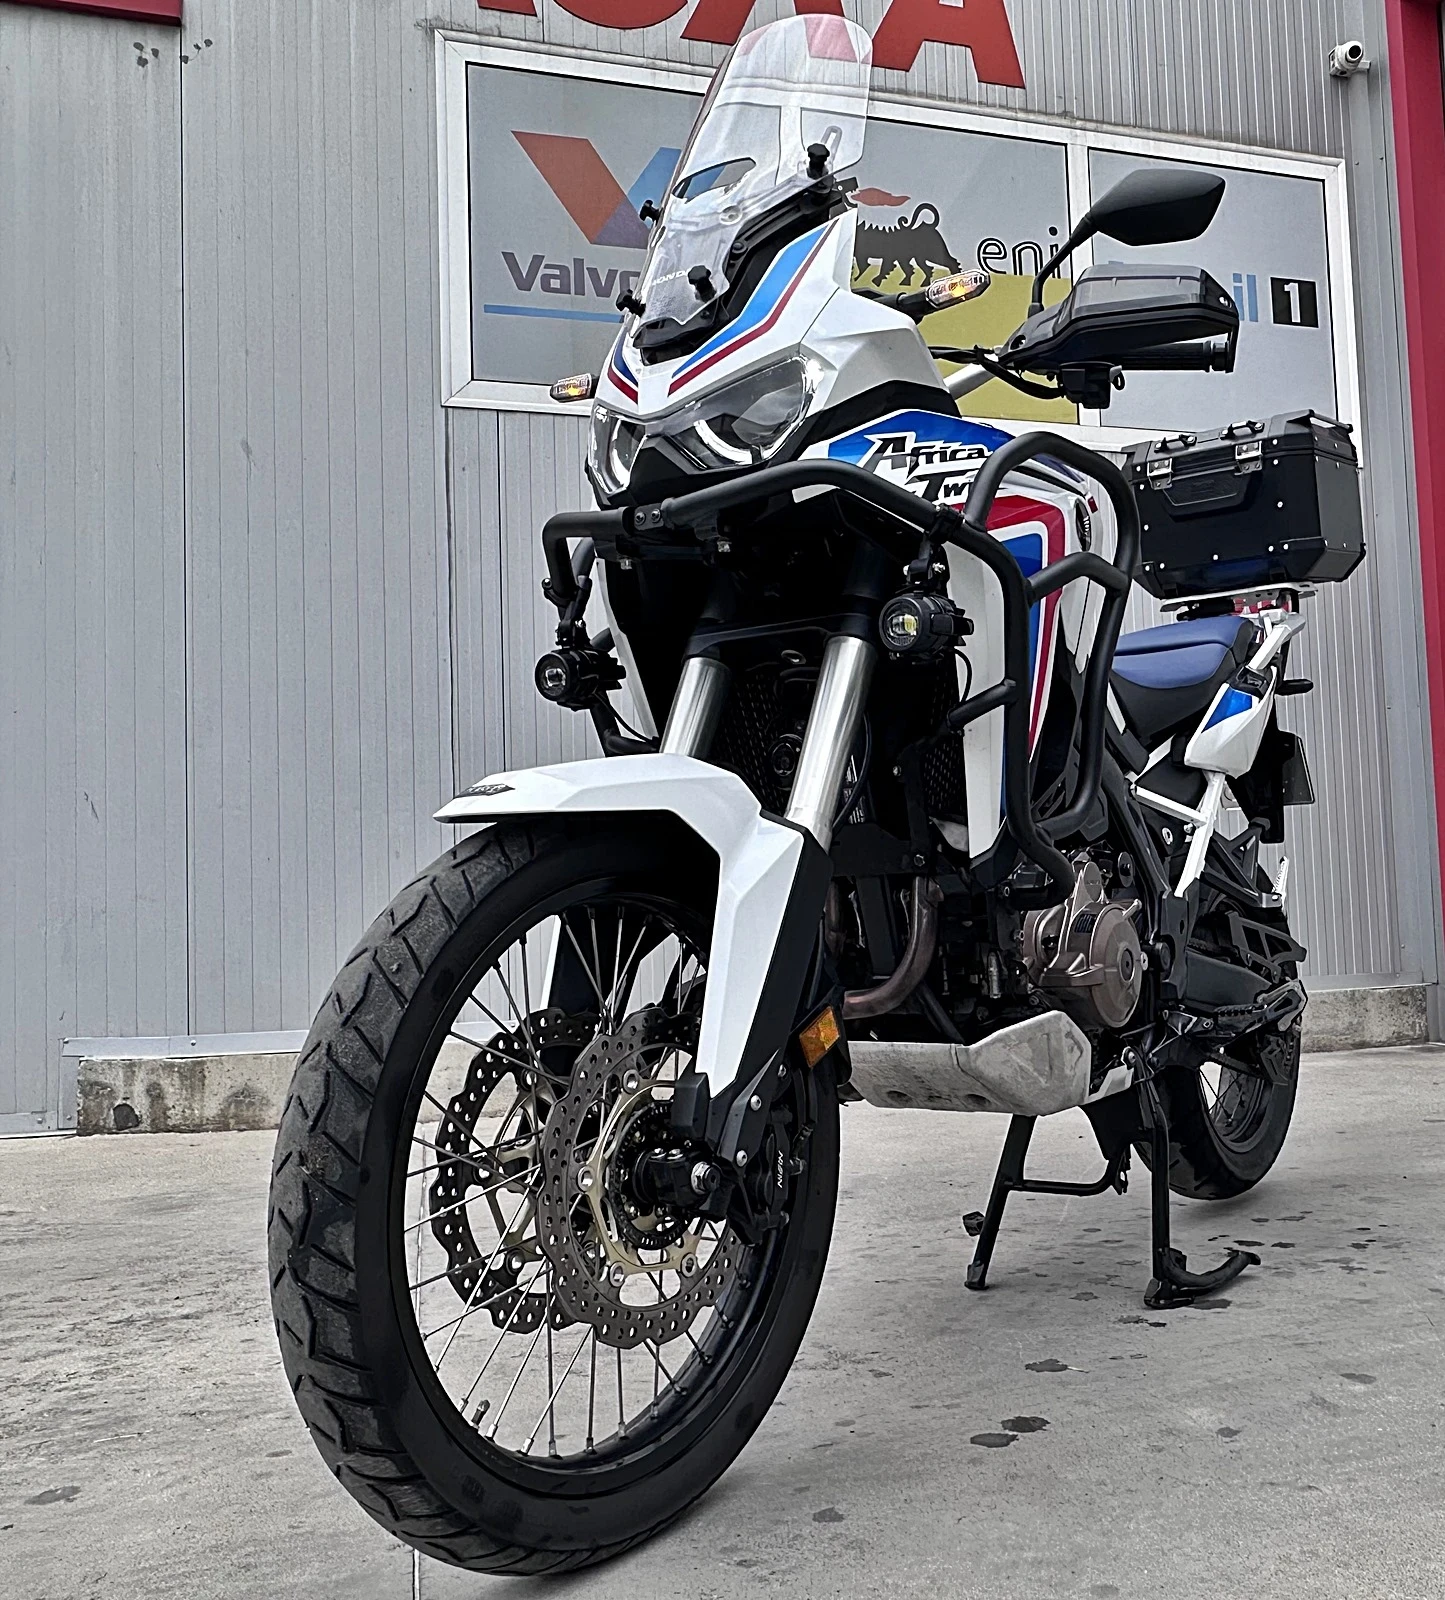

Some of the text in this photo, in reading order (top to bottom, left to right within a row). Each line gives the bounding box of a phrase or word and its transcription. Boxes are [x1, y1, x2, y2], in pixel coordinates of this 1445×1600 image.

[977, 226, 1062, 279] eni
[652, 268, 690, 286] HOND
[1284, 282, 1301, 323] 1
[862, 436, 991, 479] Africa
